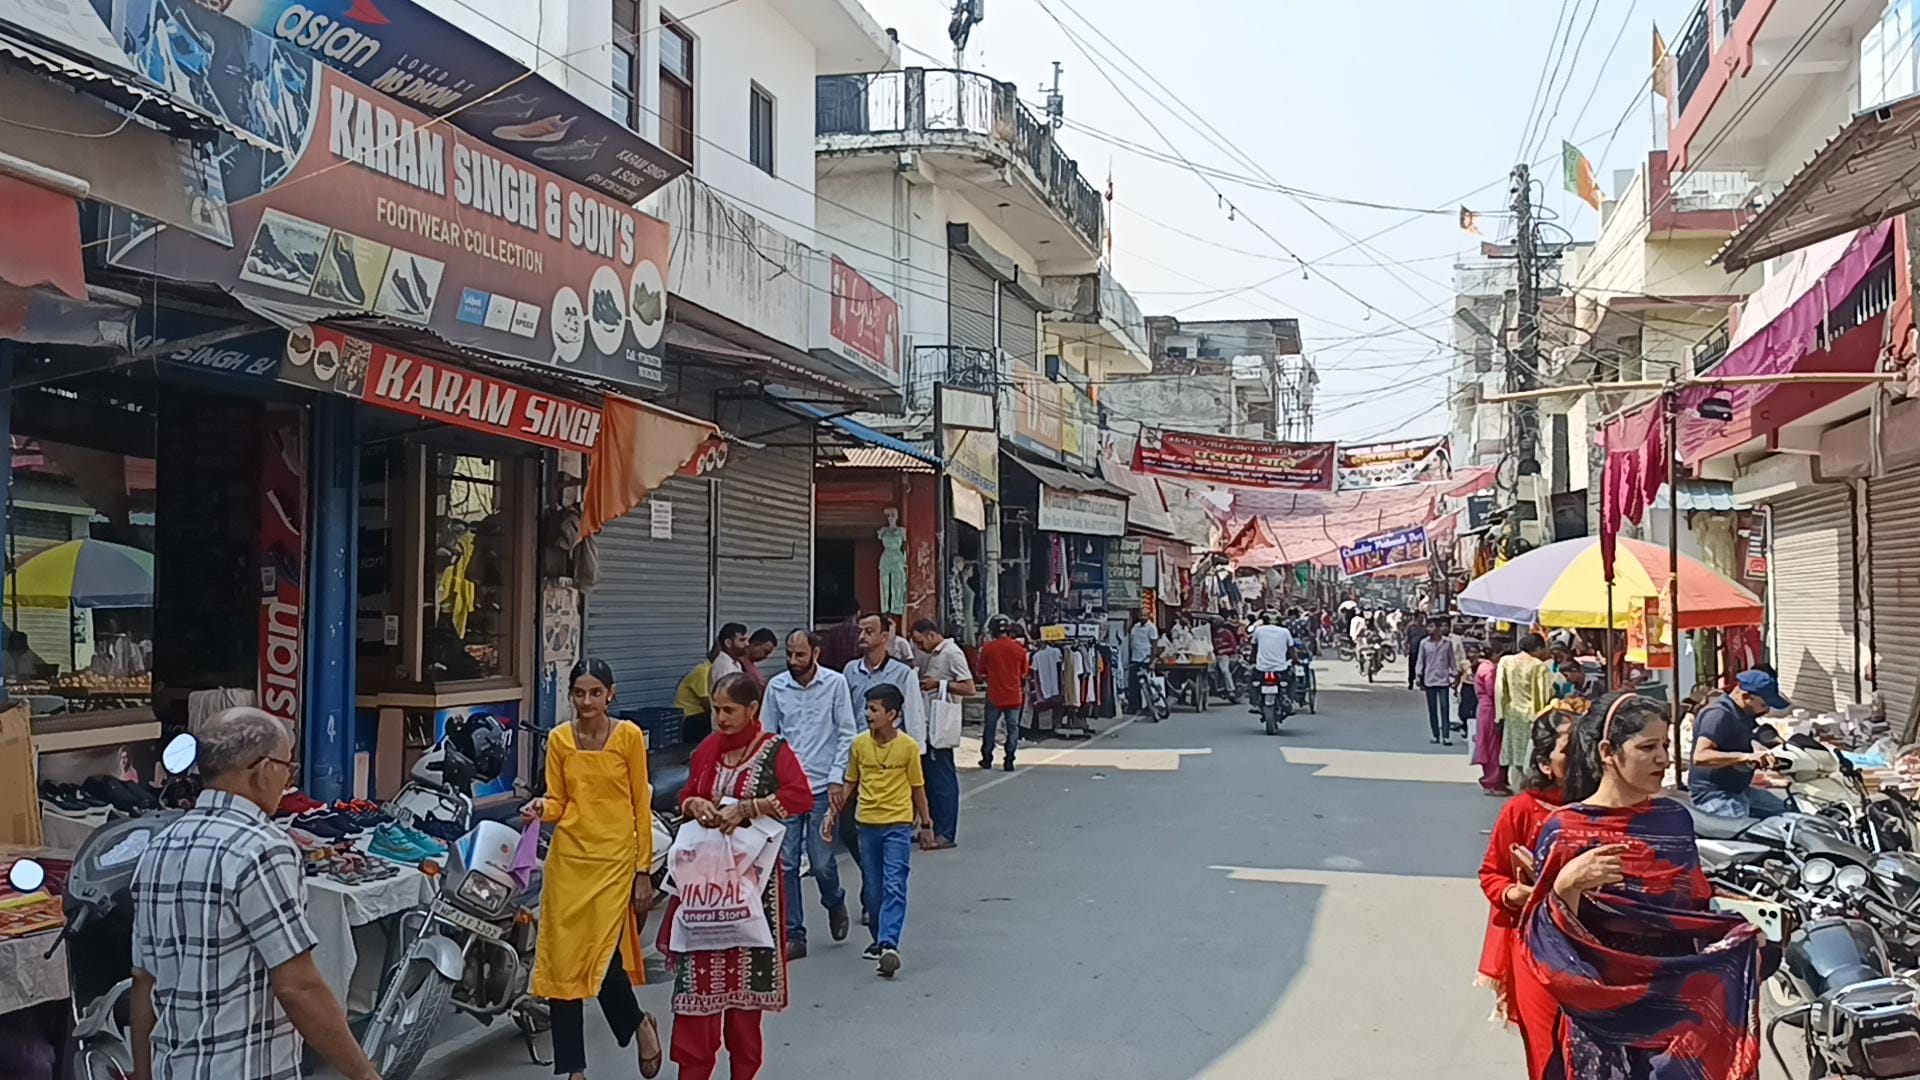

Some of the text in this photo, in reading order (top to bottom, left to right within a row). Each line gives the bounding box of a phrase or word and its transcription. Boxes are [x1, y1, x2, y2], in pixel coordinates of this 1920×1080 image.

[275, 4, 380, 68] asian
[397, 53, 448, 81] LOVED
[371, 67, 464, 109] MS DHONI
[330, 85, 634, 265] KARAM SINGH & SON'S
[376, 197, 544, 275] FOOTWEAR COLLECTION
[375, 353, 517, 427] KARAM
[265, 596, 299, 741] sian
[685, 909, 748, 922] eneral Store
